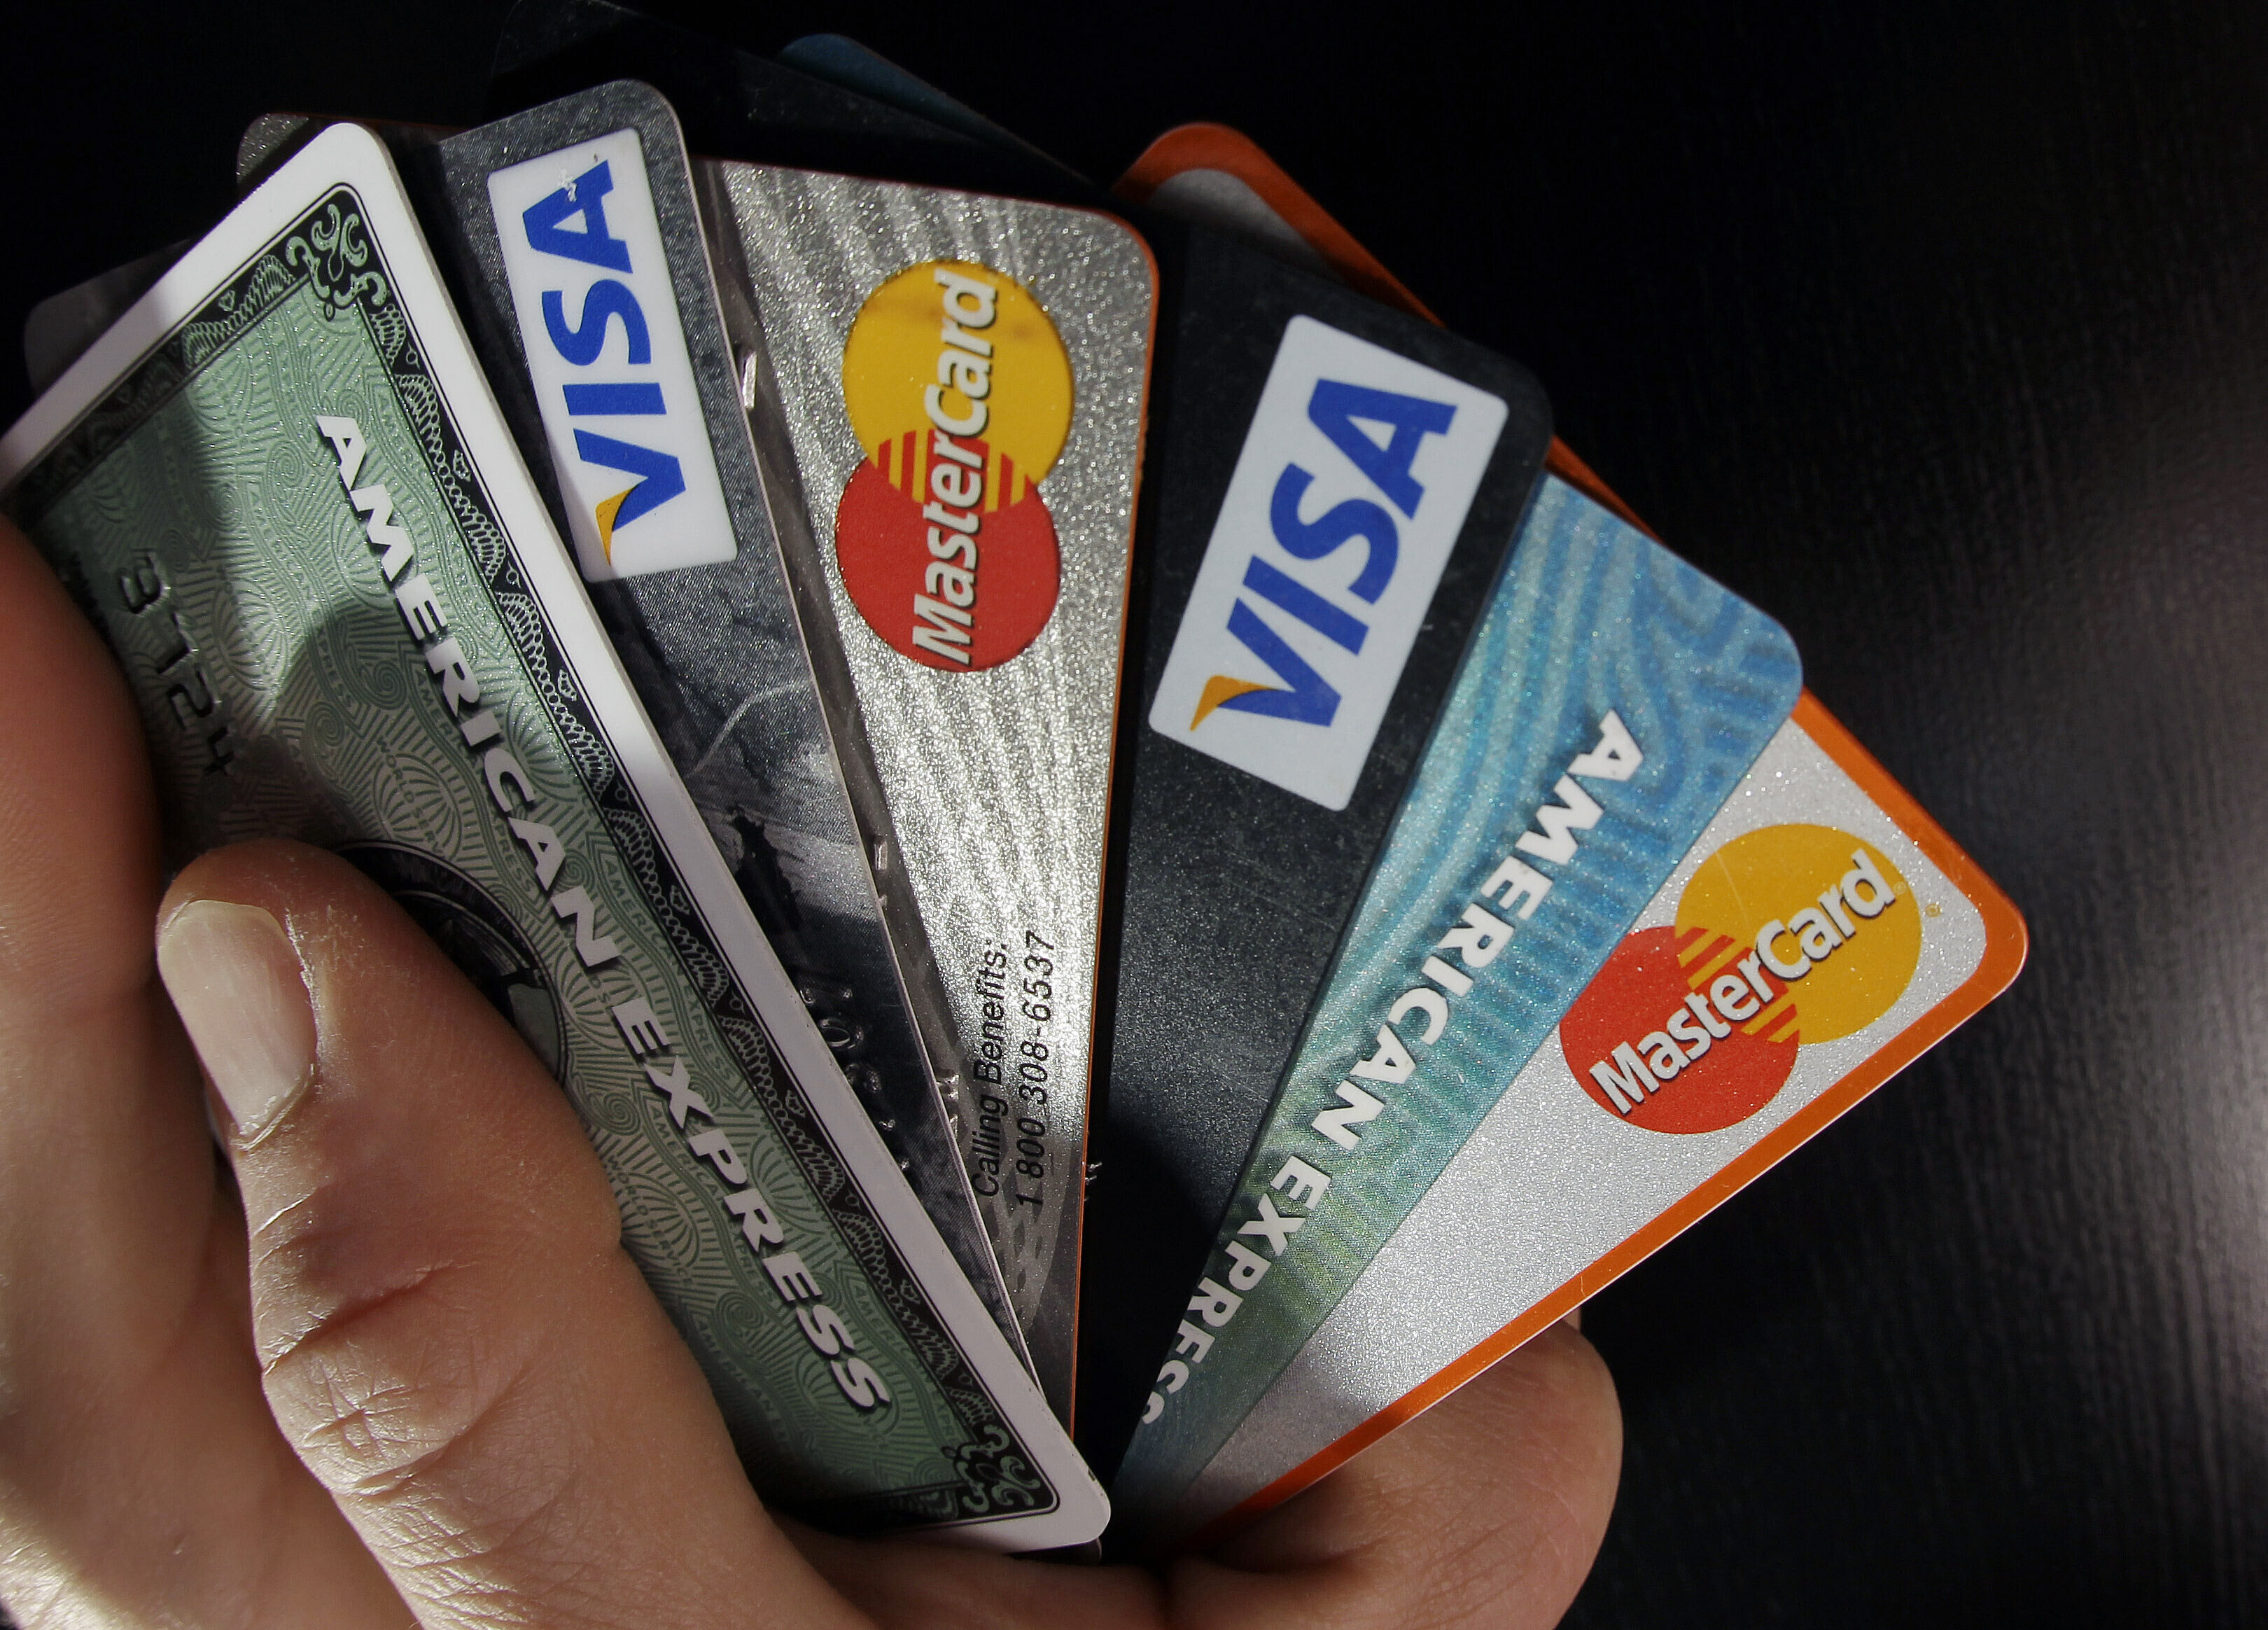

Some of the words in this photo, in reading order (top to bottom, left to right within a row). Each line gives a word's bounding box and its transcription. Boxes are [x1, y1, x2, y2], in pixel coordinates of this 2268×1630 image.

[523, 160, 686, 566] VISA
[912, 267, 997, 664] MasterCard
[1190, 378, 1457, 731] VISA
[374, 735, 416, 804] WORLD
[412, 807, 448, 864] SERV
[484, 794, 534, 893] XPRESS
[316, 415, 620, 967] AMERICAN
[612, 998, 890, 1407] EXPRESS
[601, 862, 683, 976] AMERICAN
[682, 984, 735, 1082] EXPRESS
[1311, 709, 1644, 1150] AMERICAN
[1588, 849, 1896, 1115] MasterCard
[974, 940, 1008, 1085] Benefits:
[1018, 929, 1054, 1106] 308-6537
[606, 1155, 650, 1218] WORLD
[645, 1218, 694, 1288] SERVICE
[972, 1096, 1008, 1197] Calling
[1015, 1192, 1044, 1208] 1
[1016, 1116, 1045, 1180] 800
[729, 1221, 776, 1302] XPRESS
